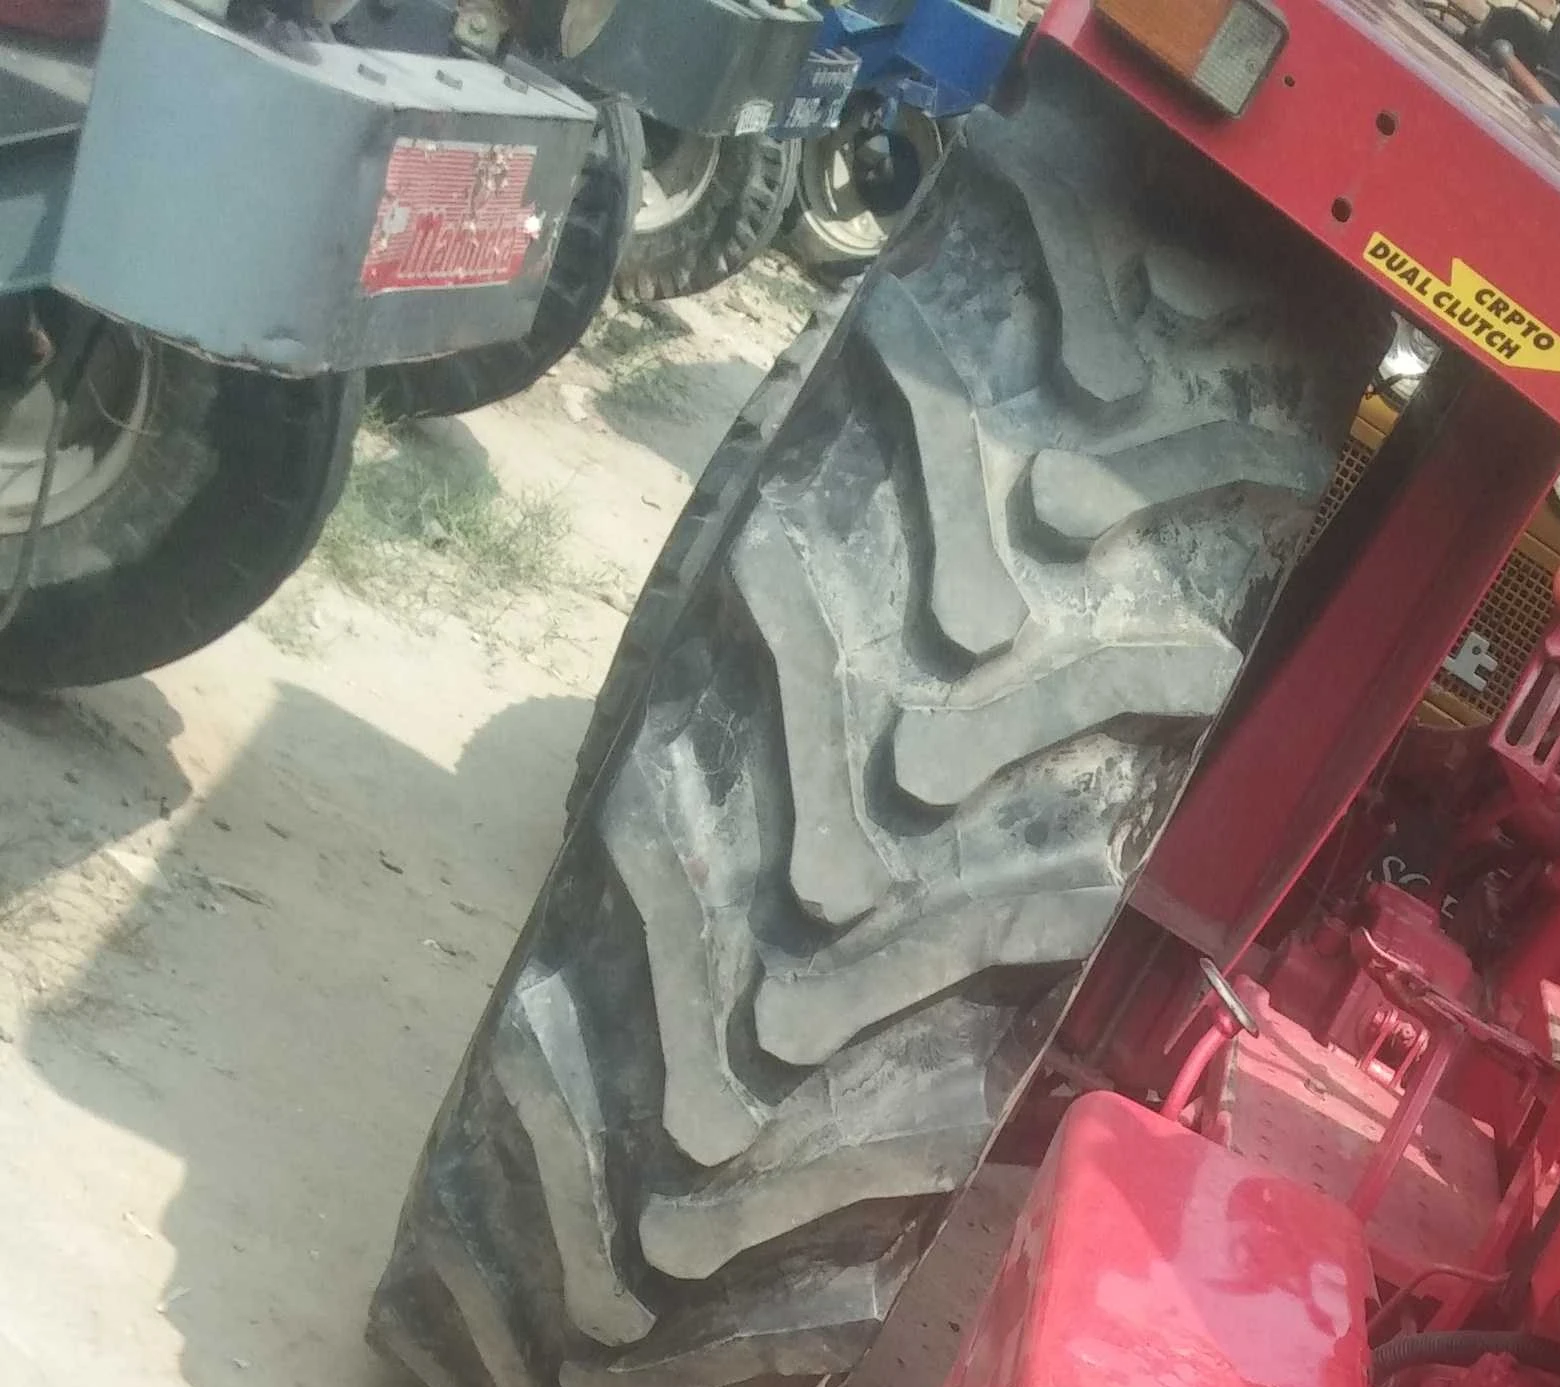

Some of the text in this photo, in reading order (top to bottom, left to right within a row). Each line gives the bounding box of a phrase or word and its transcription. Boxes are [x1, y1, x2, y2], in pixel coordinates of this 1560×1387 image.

[1367, 240, 1522, 360] DUAL CLUTCH
[1474, 288, 1555, 351] CRPTO
